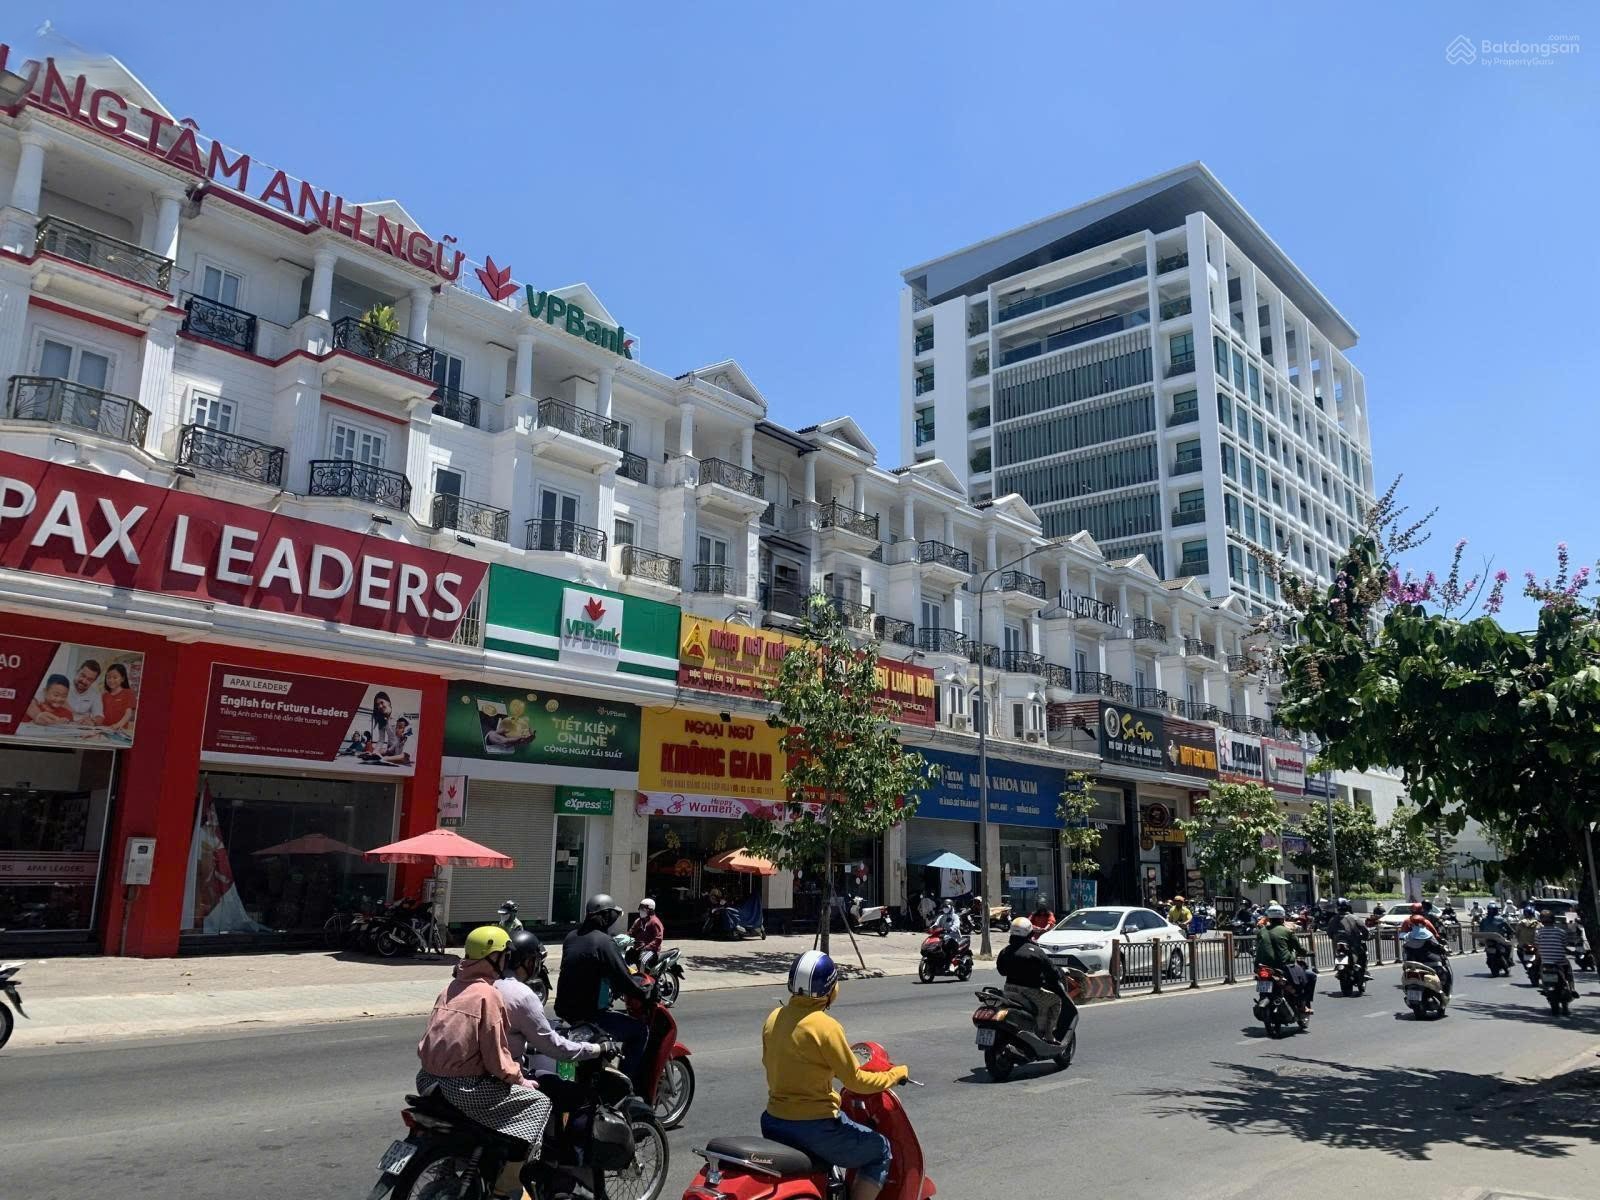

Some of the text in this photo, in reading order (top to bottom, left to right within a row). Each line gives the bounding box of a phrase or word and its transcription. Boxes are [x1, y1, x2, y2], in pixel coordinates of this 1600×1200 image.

[140, 107, 250, 191] TÂM
[259, 170, 362, 240] ANH
[375, 215, 466, 281] NGỮ
[525, 284, 634, 360] VPBank
[170, 514, 464, 622] LEADERS
[565, 618, 620, 643] VPBank
[230, 678, 288, 692] APAX LEADERS
[220, 695, 349, 718] English for Future Leaders
[606, 709, 627, 719] VPBank
[902, 701, 927, 711] SCHOOL
[552, 715, 582, 732] TIẾT
[685, 719, 755, 740] NGOẠI NGỮ
[558, 731, 608, 747] ONLINE
[544, 743, 568, 755] CỘNG
[569, 746, 590, 757] NGAY
[604, 747, 623, 759] SUẤT
[661, 740, 772, 781] KHÔNG GIAN
[992, 776, 1019, 792] KHOA
[1020, 780, 1038, 795] KIM
[565, 798, 601, 811] eXpress
[689, 802, 742, 815] Women's
